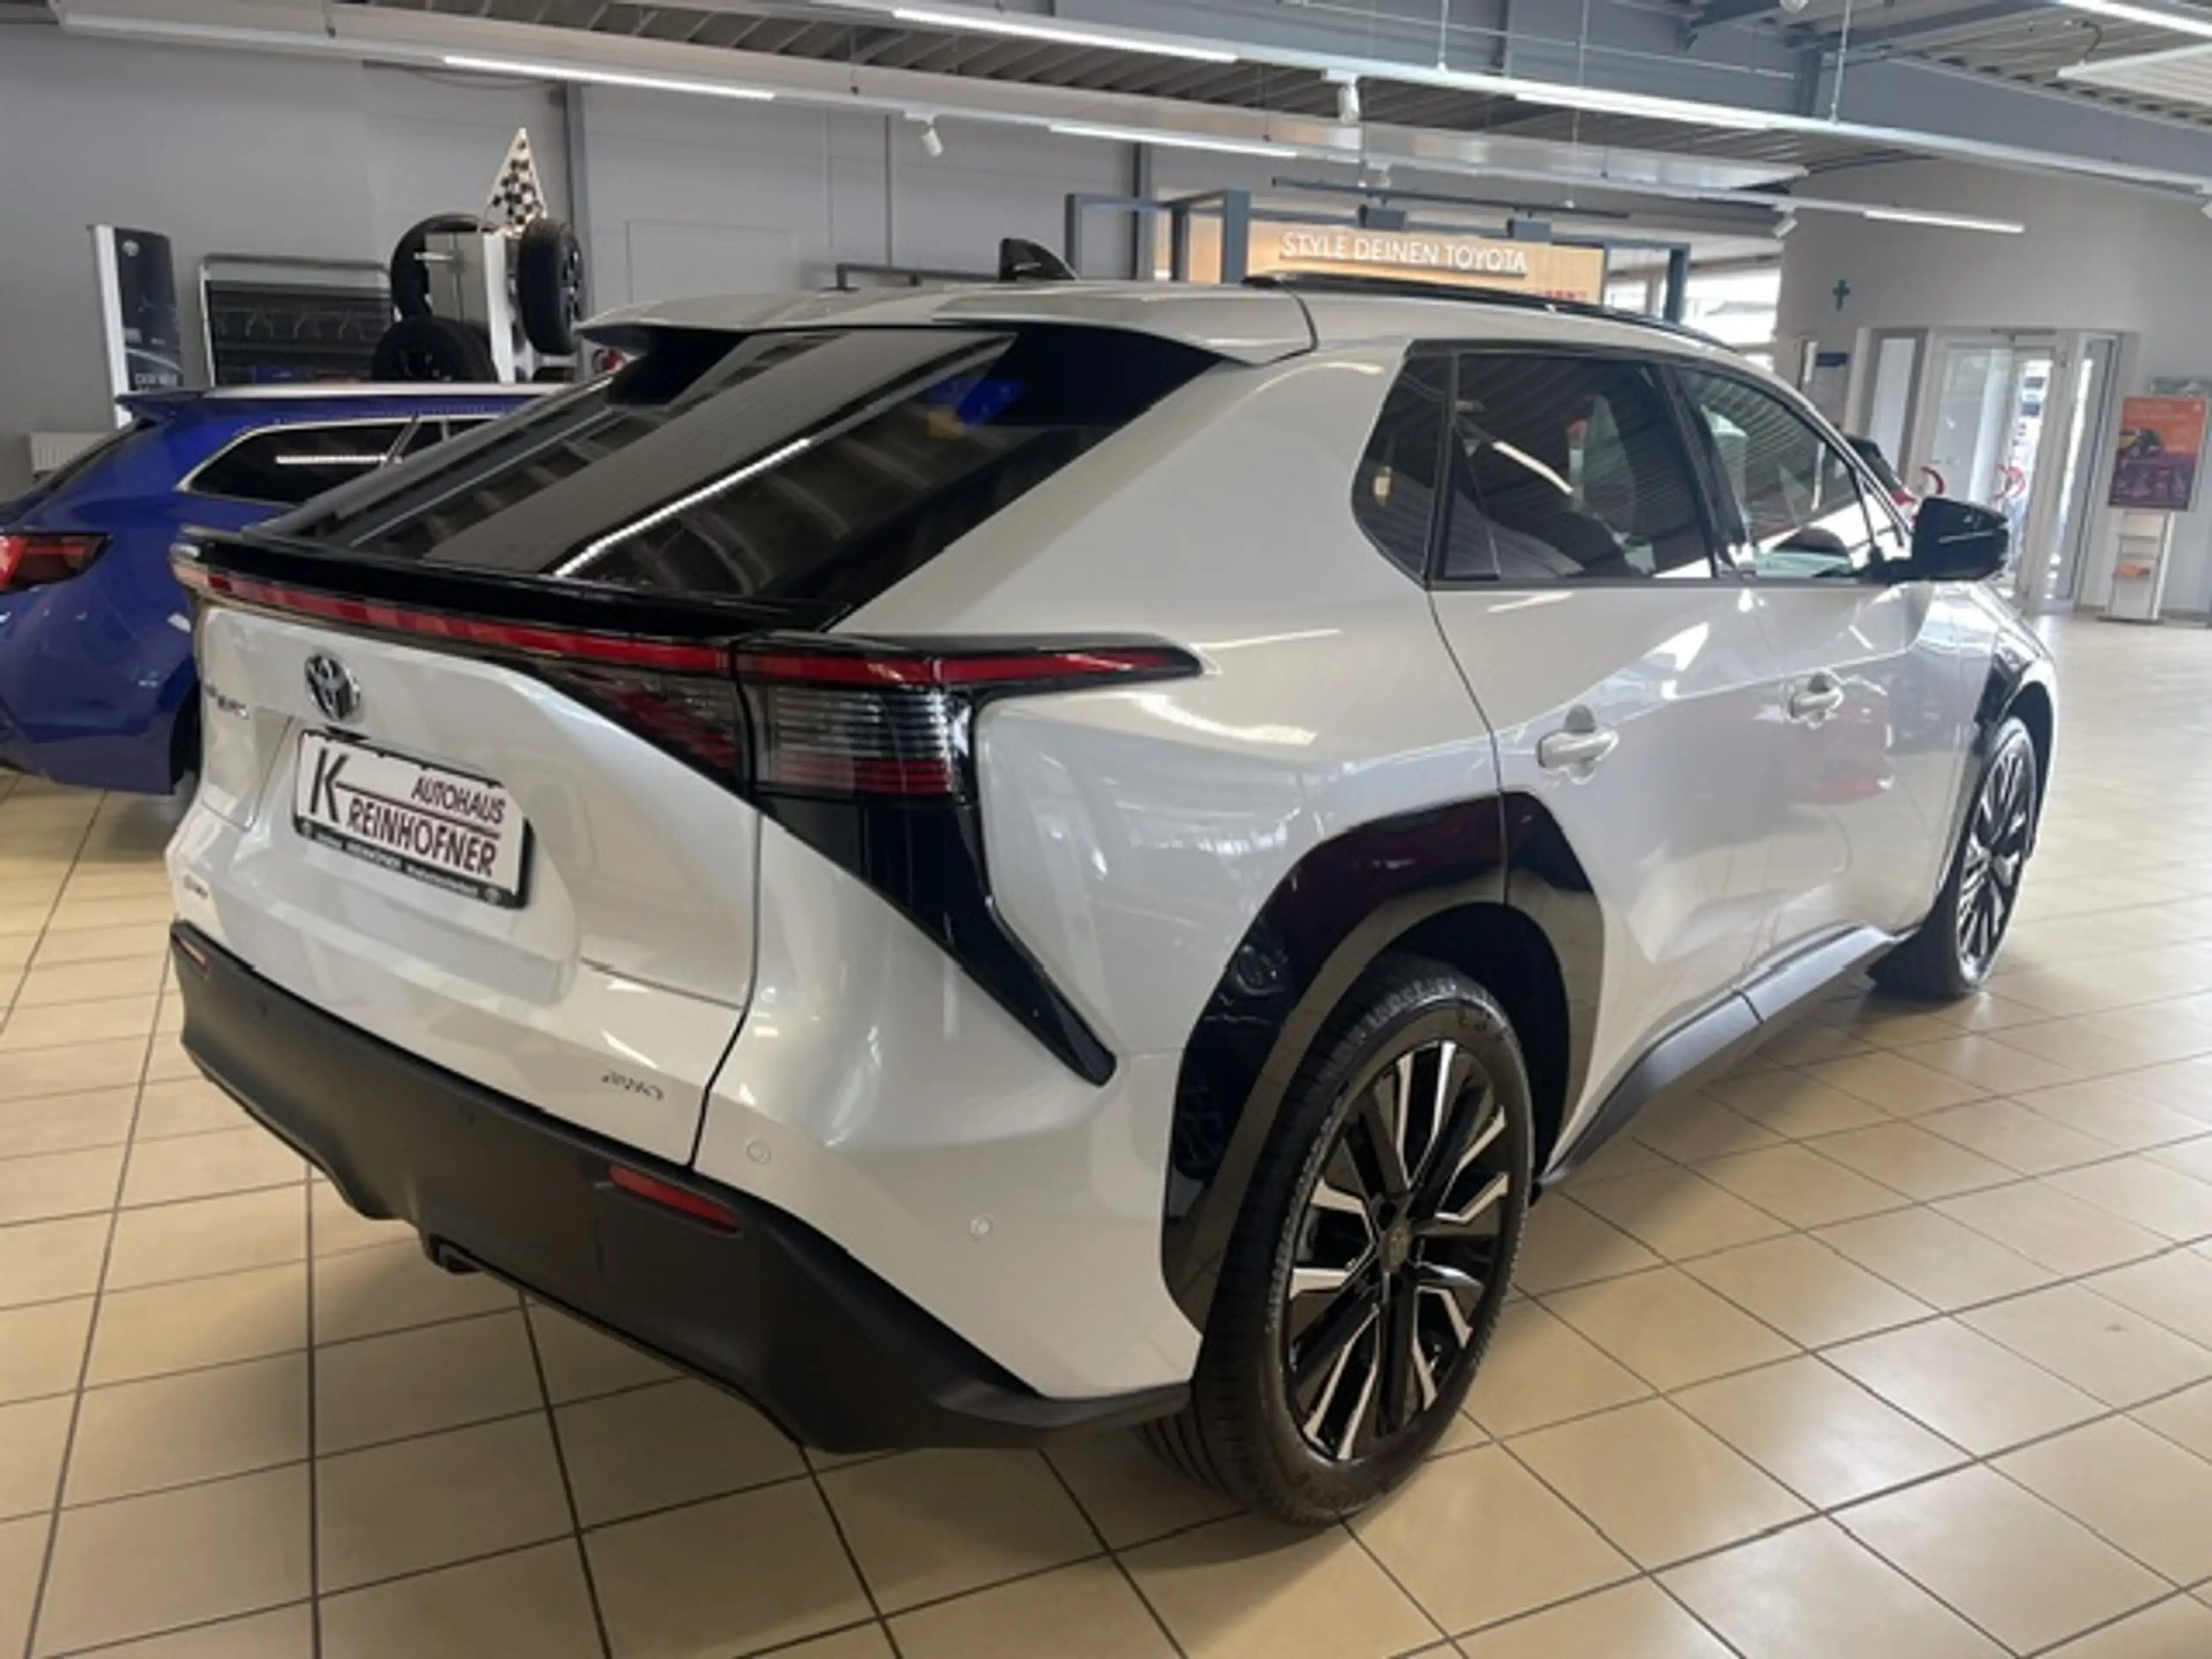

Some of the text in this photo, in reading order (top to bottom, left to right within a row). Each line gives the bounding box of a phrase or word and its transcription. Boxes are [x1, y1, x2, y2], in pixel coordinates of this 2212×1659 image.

[1281, 232, 1527, 272] STYLE DEINEN TOYOTA
[311, 748, 349, 823] K
[411, 777, 507, 825] AUTOHAUS
[348, 798, 497, 877] REINHOFNER
